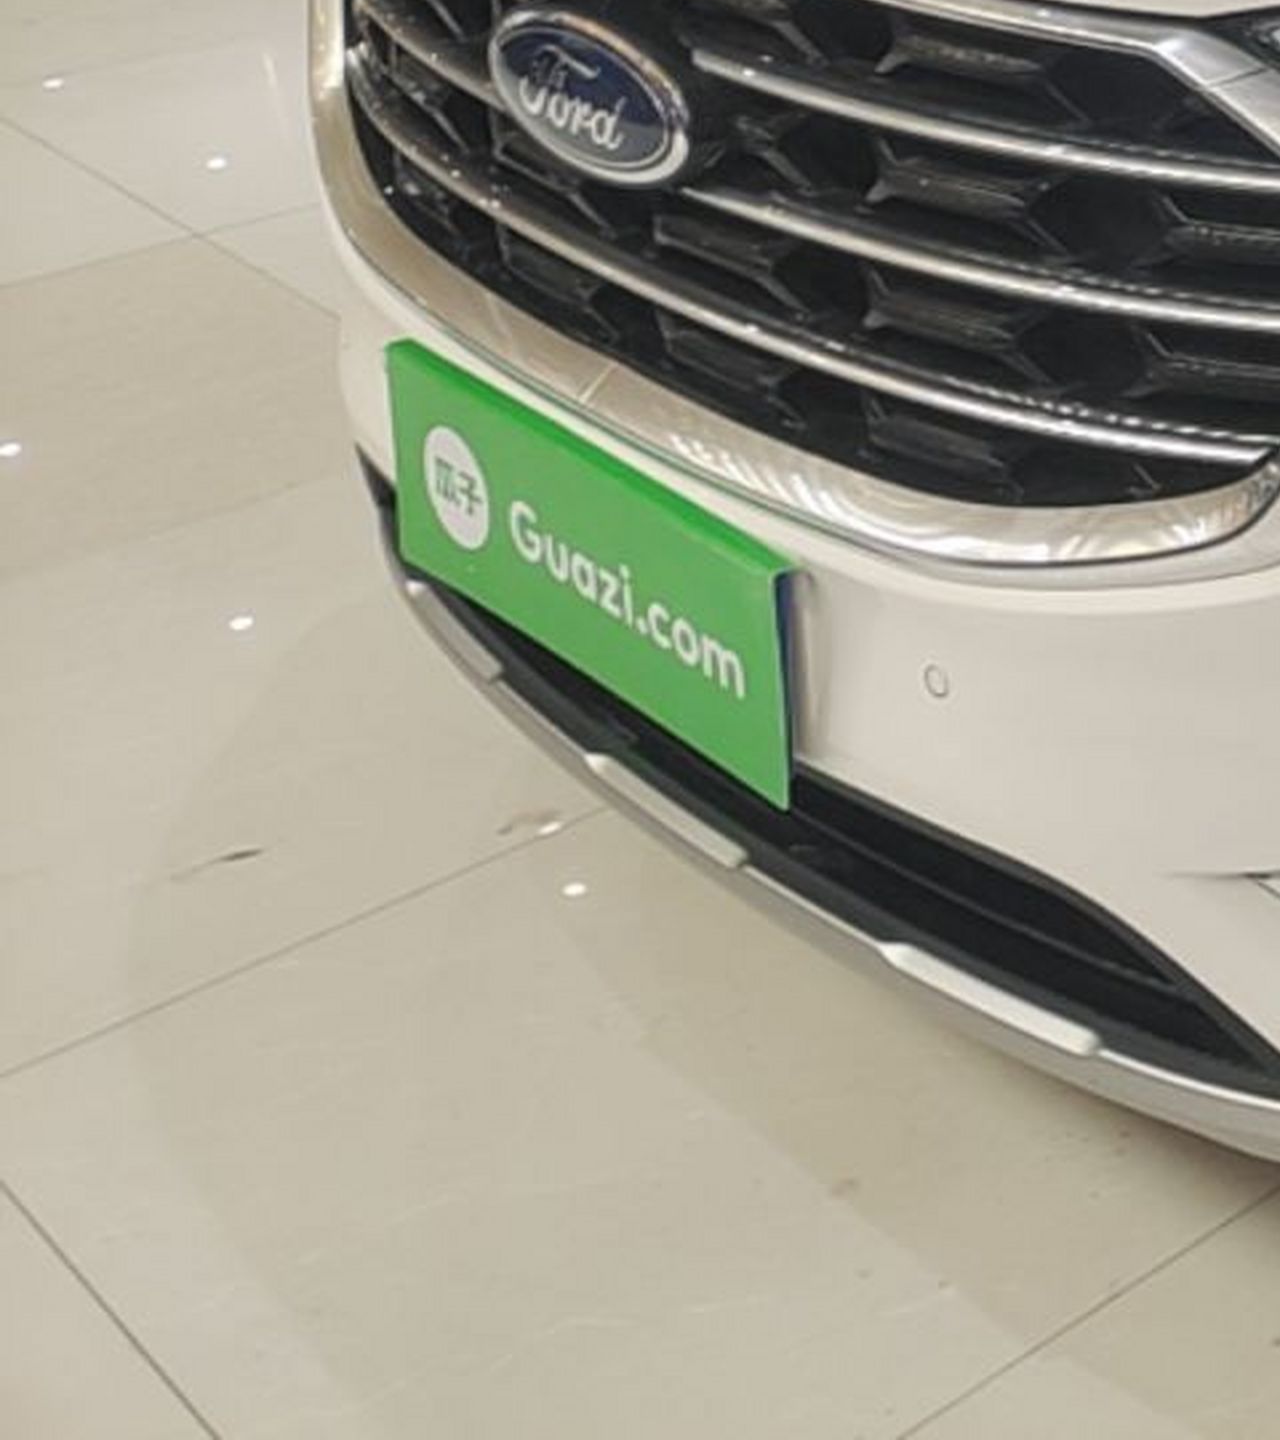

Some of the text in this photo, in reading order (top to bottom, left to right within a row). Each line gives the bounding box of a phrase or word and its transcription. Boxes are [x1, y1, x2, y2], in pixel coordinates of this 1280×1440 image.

[518, 44, 627, 150] Ford
[433, 456, 482, 516] 瓜子
[510, 500, 746, 698] Guazi.com
